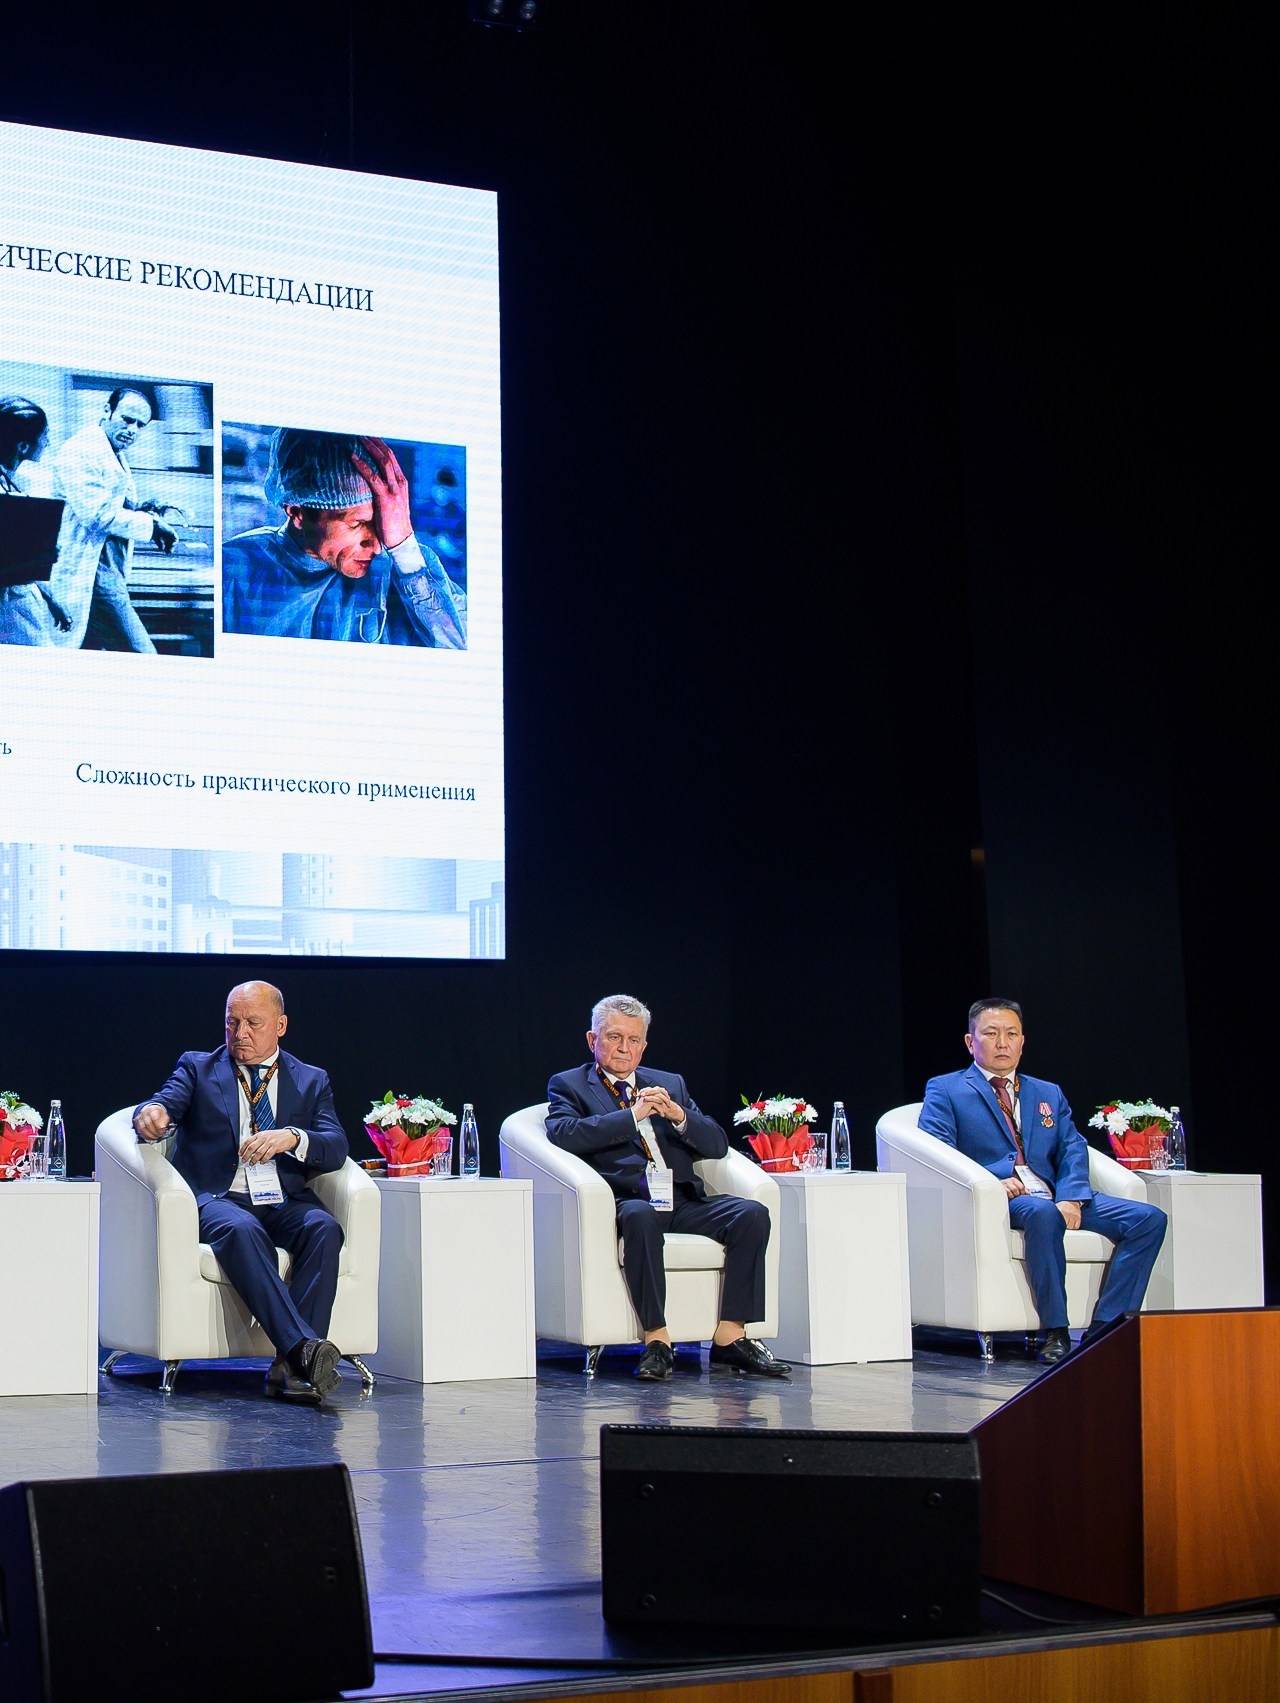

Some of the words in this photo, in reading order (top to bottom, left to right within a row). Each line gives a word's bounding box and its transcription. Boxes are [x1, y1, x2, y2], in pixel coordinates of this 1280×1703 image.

[140, 261, 374, 312] РЕКОМЕНДАЦИИ
[75, 762, 196, 788] Сложность
[202, 775, 351, 795] практического
[357, 782, 476, 802] применения
